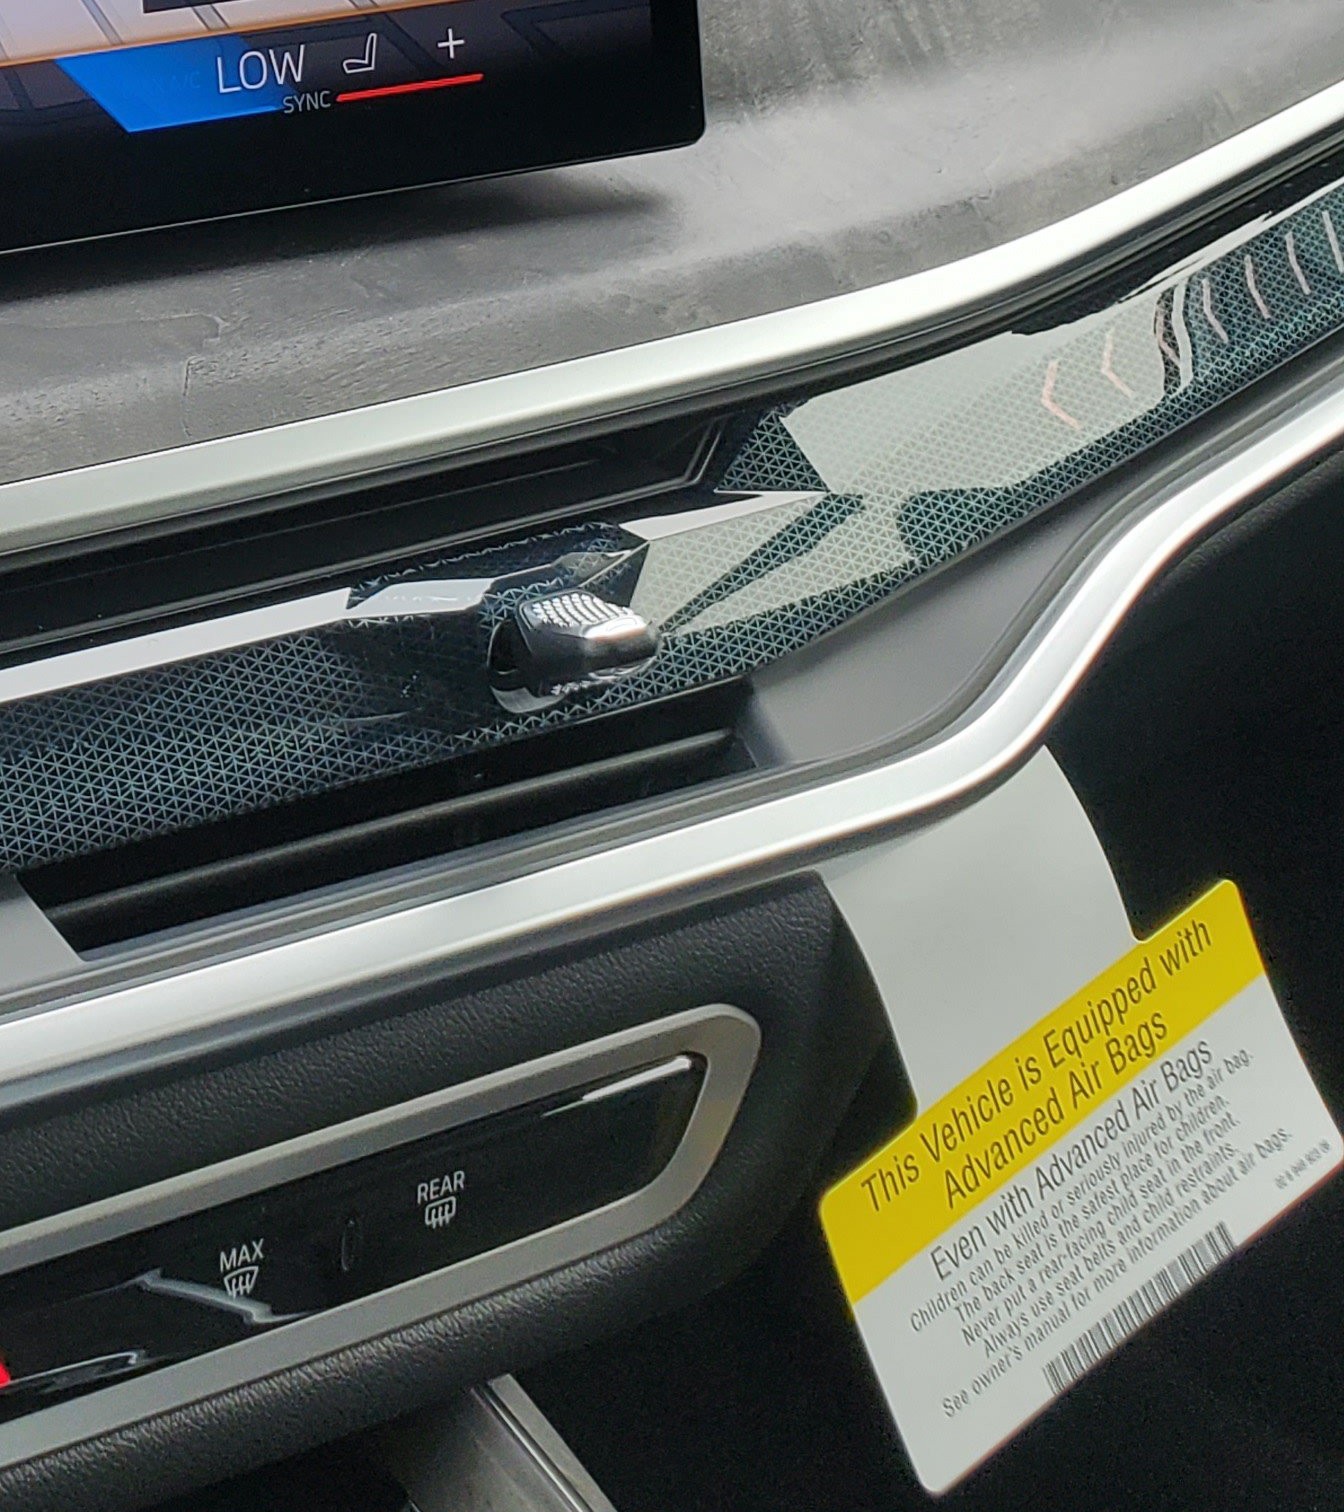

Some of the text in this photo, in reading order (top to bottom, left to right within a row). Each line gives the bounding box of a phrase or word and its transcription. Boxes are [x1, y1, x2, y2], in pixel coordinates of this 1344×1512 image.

[217, 44, 306, 94] LOW
[283, 90, 331, 114] SYNC
[861, 919, 1211, 1211] This Vehicle is Equipped with
[945, 1013, 1167, 1209] Advanced Air Bags
[931, 1041, 1212, 1281] Even with Advanced Air Bags
[416, 1170, 466, 1206] REAR
[219, 1238, 265, 1273] MAX
